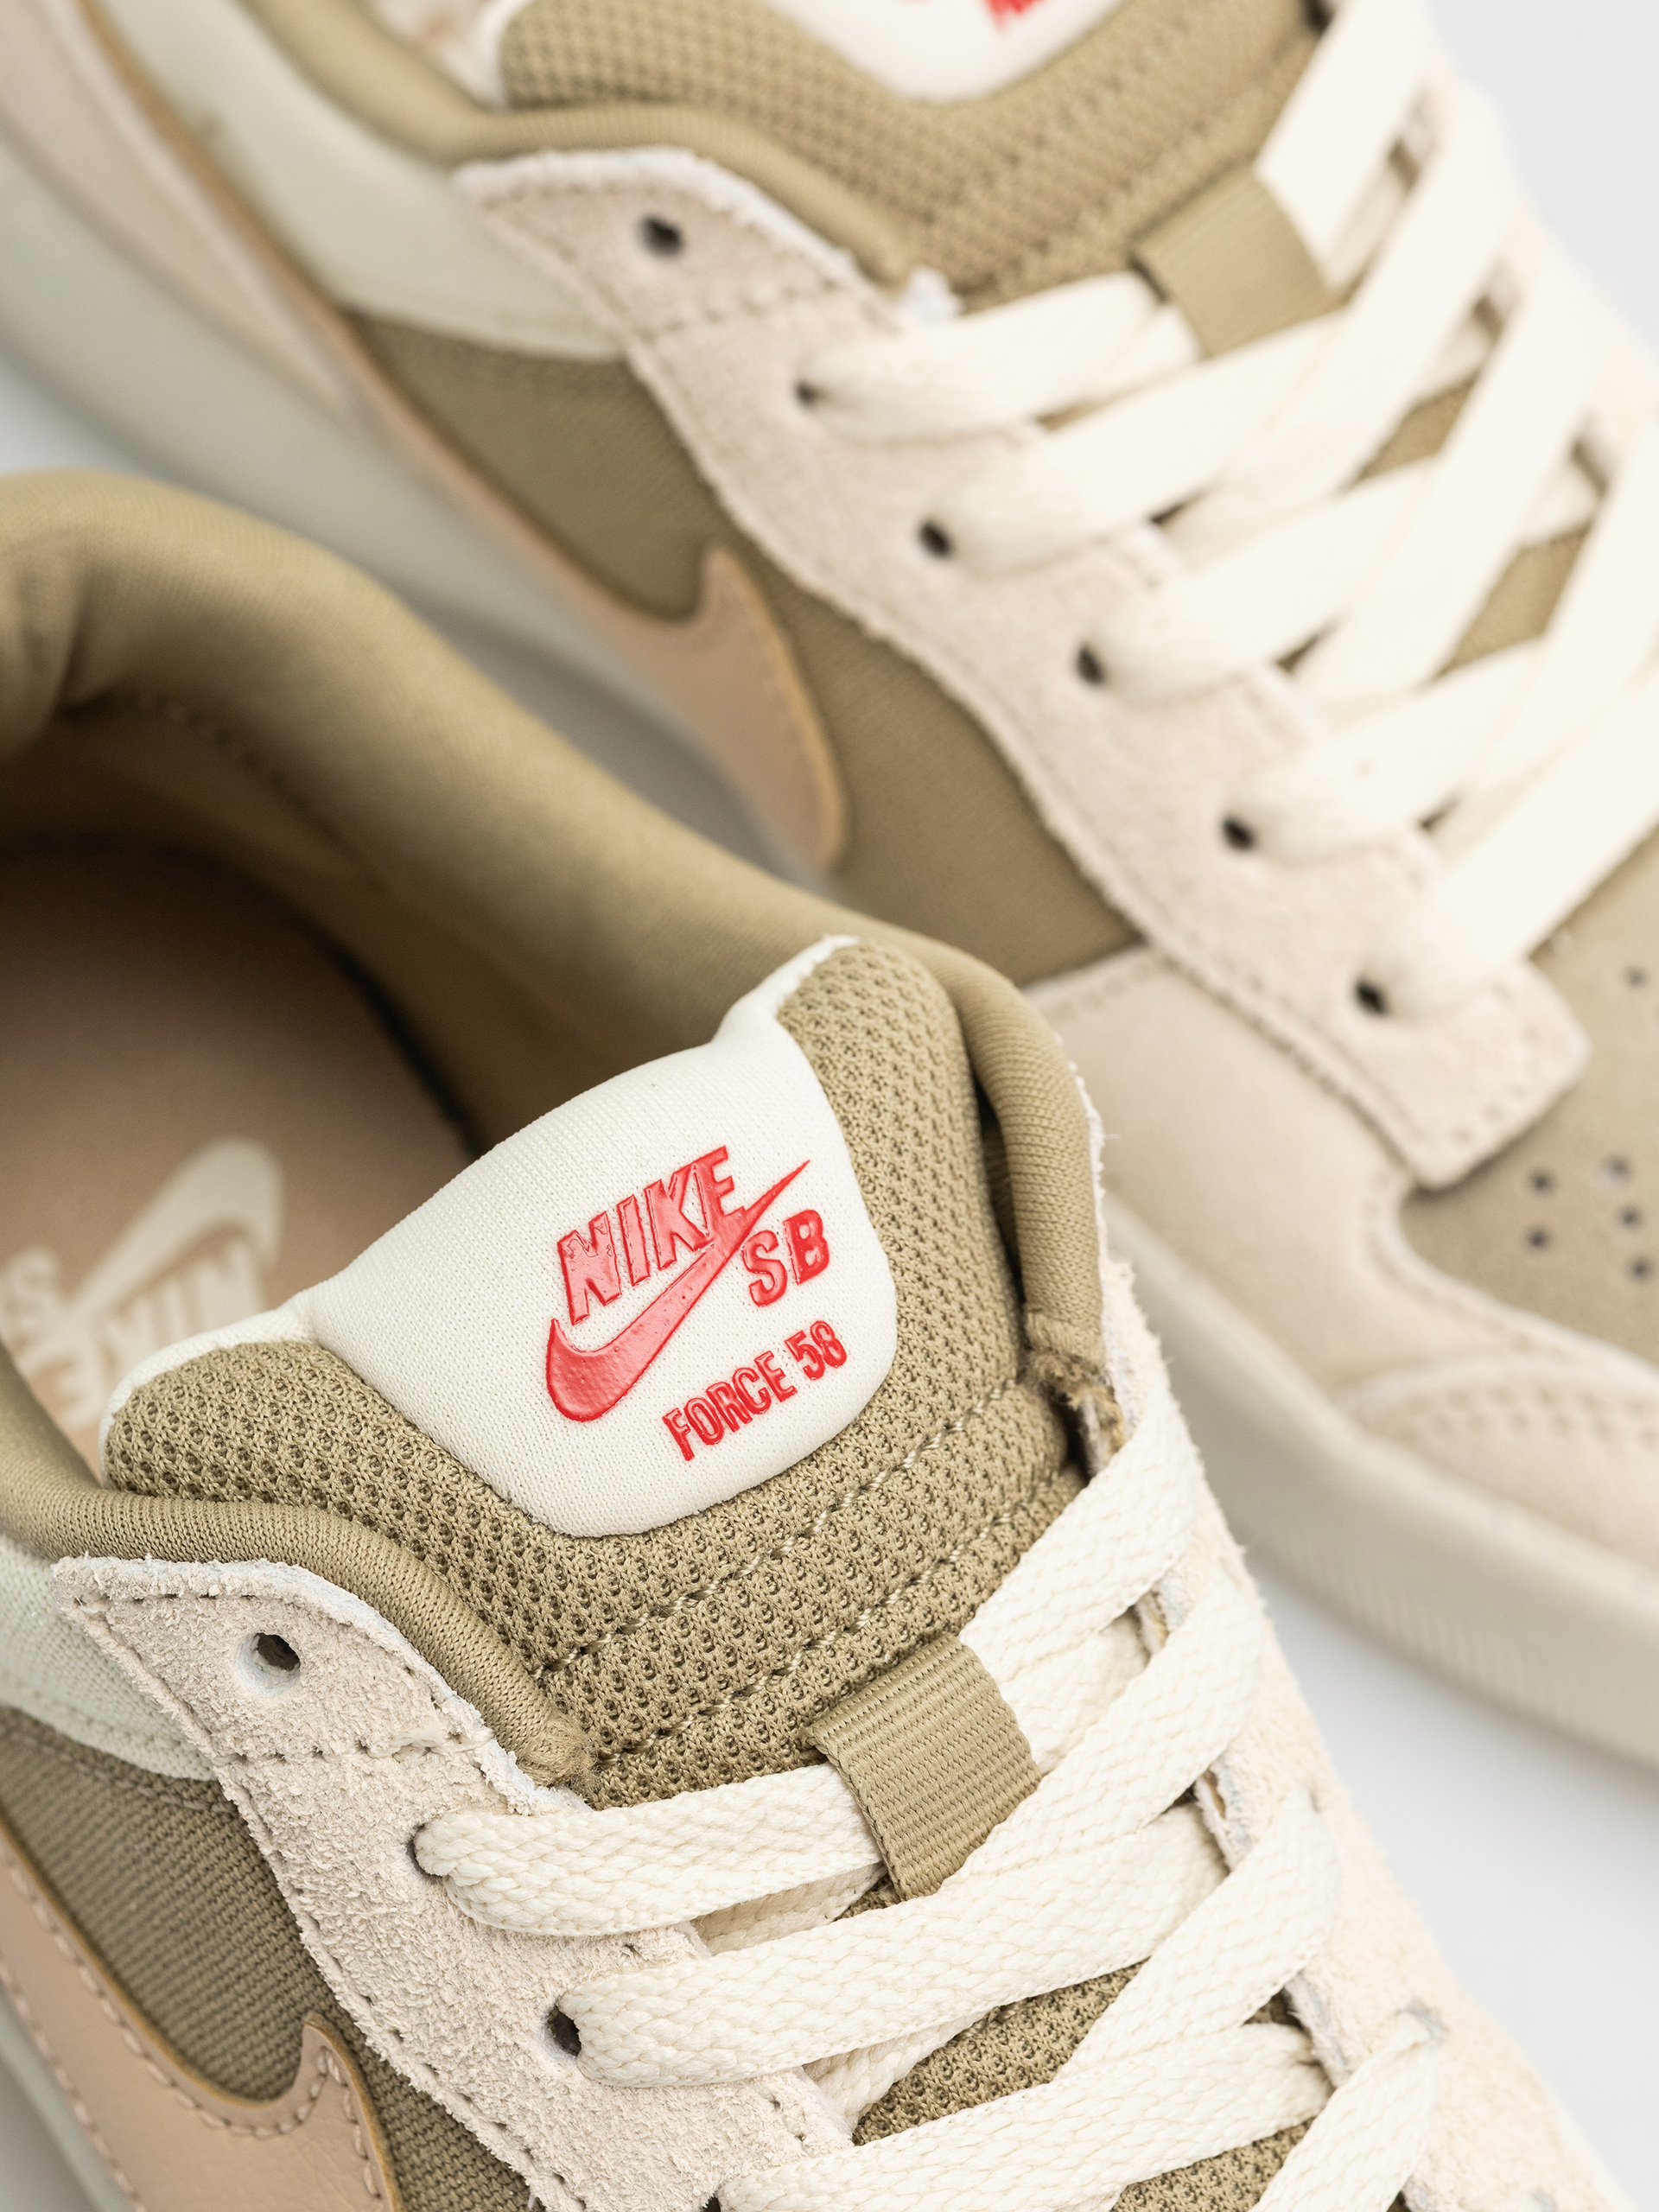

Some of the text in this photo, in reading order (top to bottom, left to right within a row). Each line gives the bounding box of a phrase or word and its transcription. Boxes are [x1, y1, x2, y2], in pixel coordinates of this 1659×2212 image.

[556, 1144, 831, 1326] NIKE SB
[661, 1319, 849, 1462] FORCE 58
